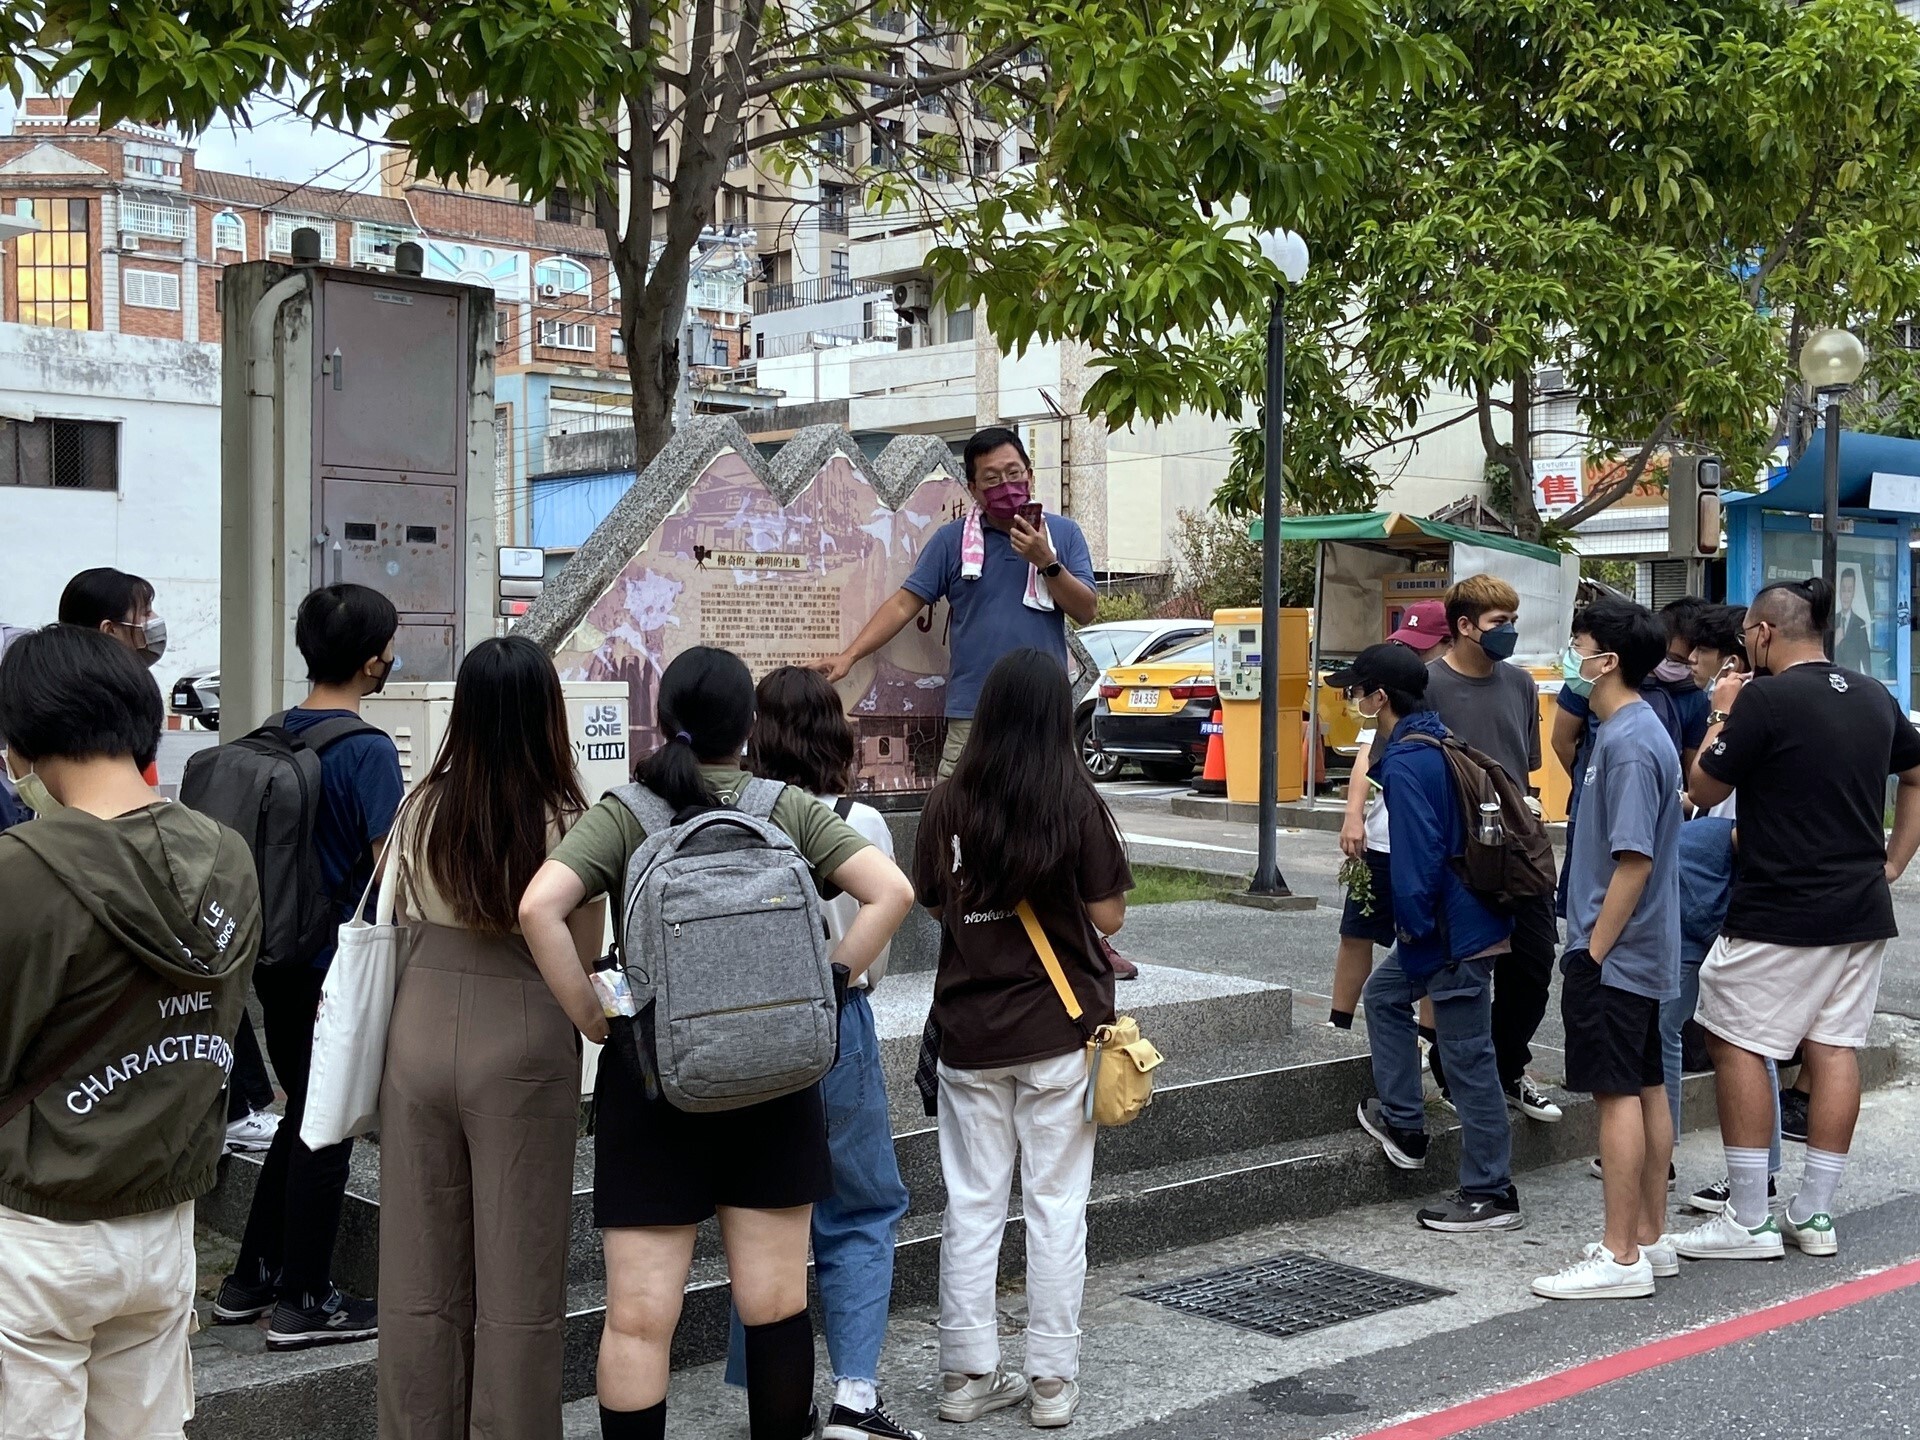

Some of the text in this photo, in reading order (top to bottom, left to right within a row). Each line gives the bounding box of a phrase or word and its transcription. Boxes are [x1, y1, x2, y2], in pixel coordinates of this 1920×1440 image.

[1537, 461, 1568, 469] CENTURY
[1537, 475, 1578, 504] 售
[514, 550, 532, 566] P
[1408, 614, 1419, 627] R
[588, 705, 617, 723] JS
[585, 723, 622, 737] ONE
[590, 744, 623, 759] KAJAY
[157, 990, 213, 1019] YNNE
